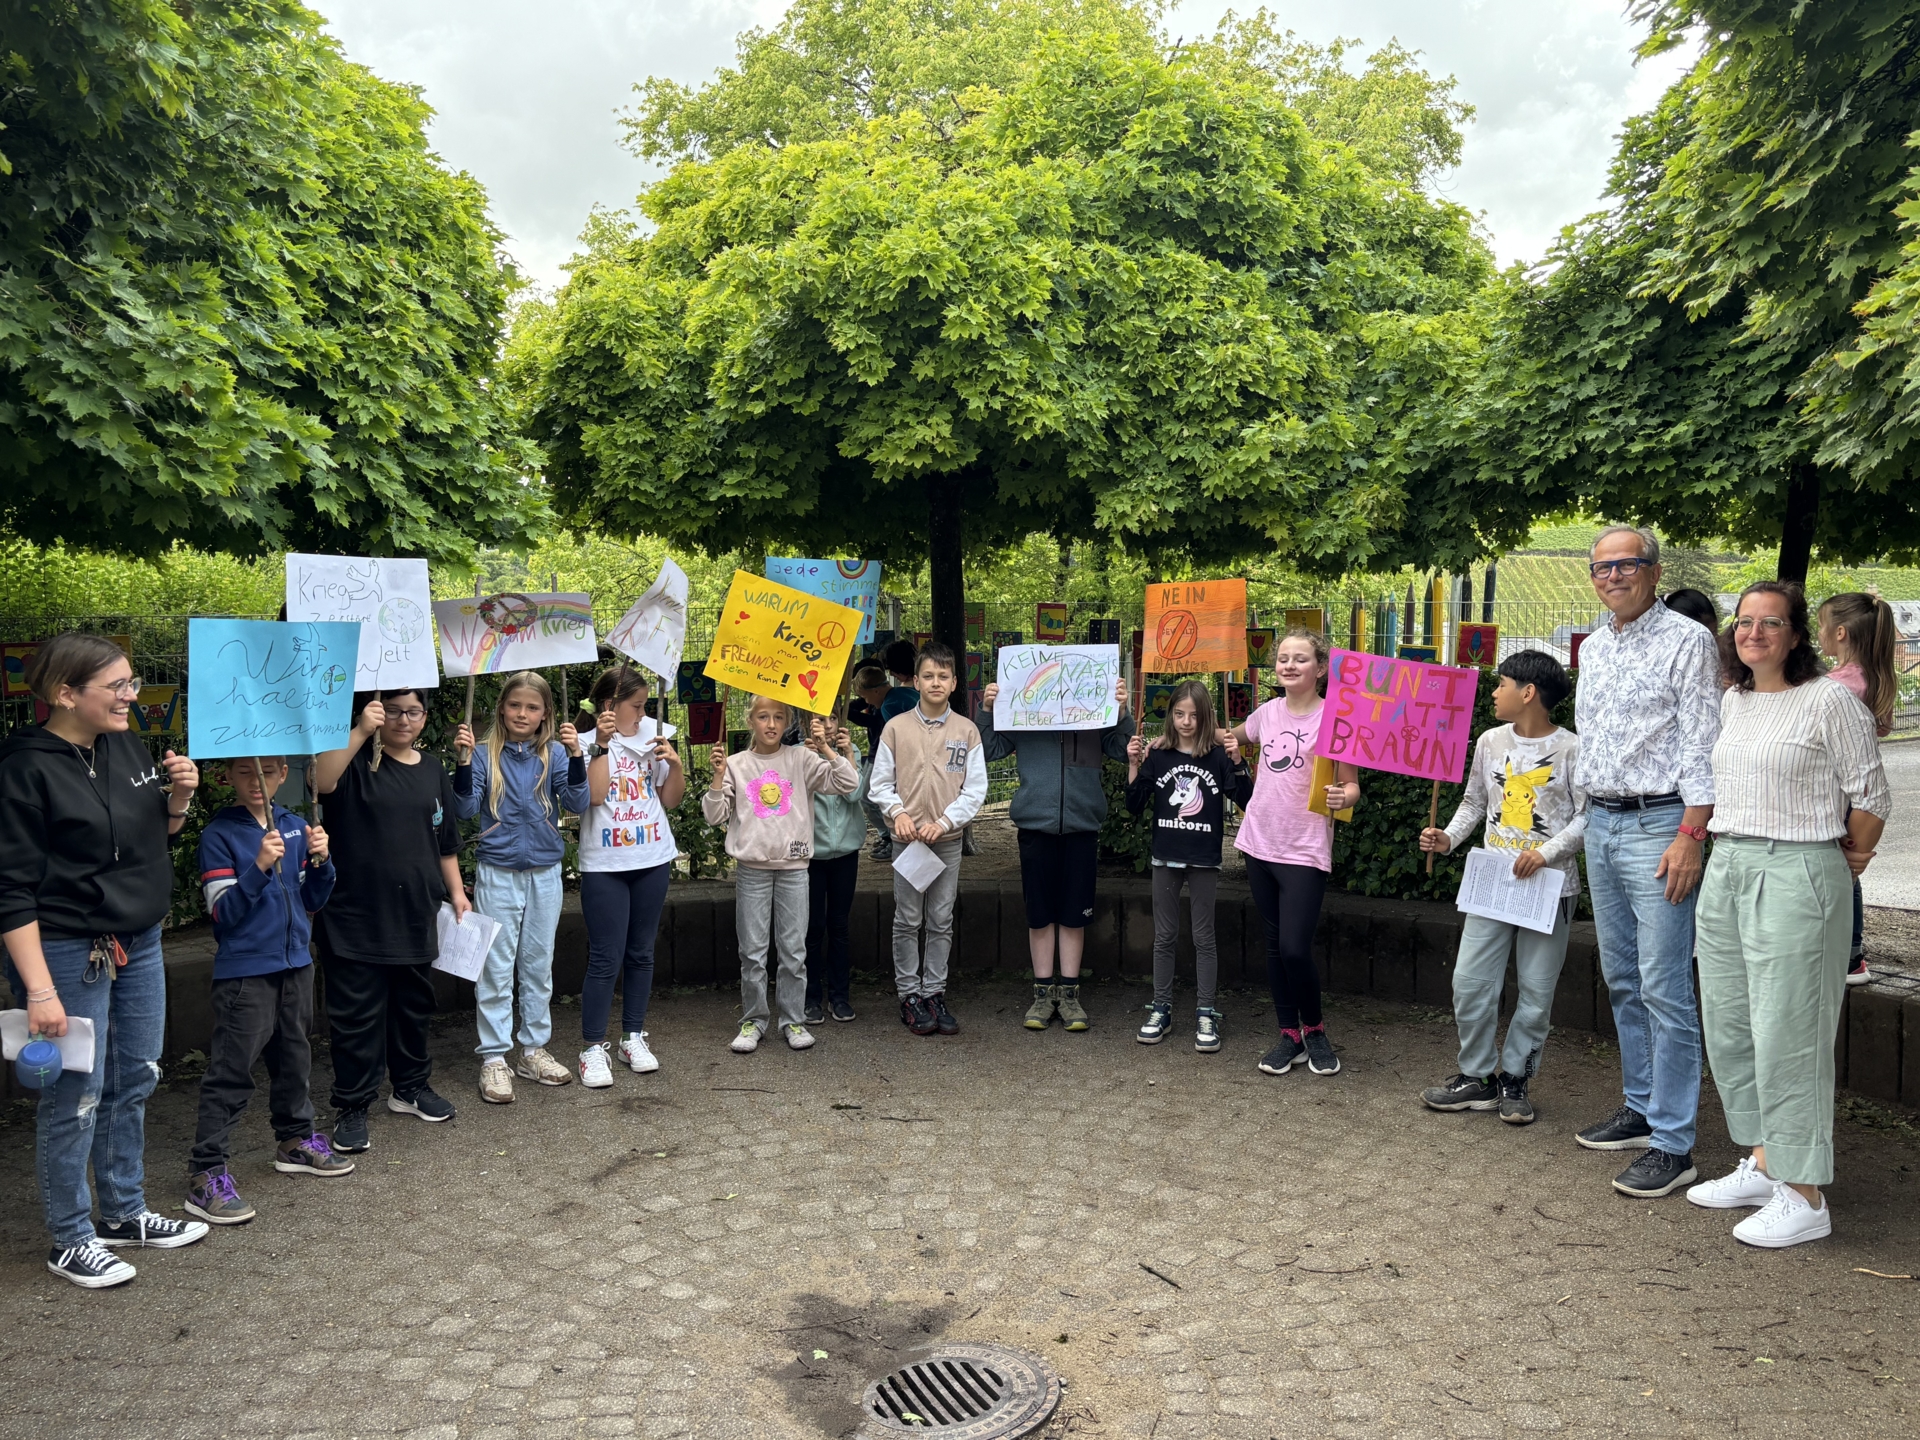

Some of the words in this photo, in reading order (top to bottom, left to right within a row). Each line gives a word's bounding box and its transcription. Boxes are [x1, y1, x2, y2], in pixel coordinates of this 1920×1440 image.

[299, 566, 352, 611] Krieg
[844, 594, 873, 609] PEACE
[1162, 586, 1206, 608] NEIN
[744, 589, 809, 619] WARUM
[538, 604, 587, 641] Krieg
[217, 639, 323, 685] Wir
[720, 644, 783, 673] FREUNDE
[733, 634, 761, 646] wenn
[777, 649, 798, 660] man
[808, 661, 831, 671] auch
[1153, 656, 1209, 673] DANKE
[723, 663, 749, 676] seien
[1336, 654, 1468, 705] BUNT
[216, 676, 330, 710] halten
[1336, 687, 1465, 731] STATT
[946, 746, 967, 766] 78
[1329, 717, 1456, 777] BRAUN
[616, 757, 636, 771] alle
[1156, 771, 1172, 789] i'm
[1171, 764, 1217, 787] actually
[1211, 786, 1219, 795] a
[612, 805, 648, 822] haben
[1158, 818, 1212, 833] unicorn
[602, 822, 661, 848] RECHTE
[1488, 832, 1544, 851] PIKACH
